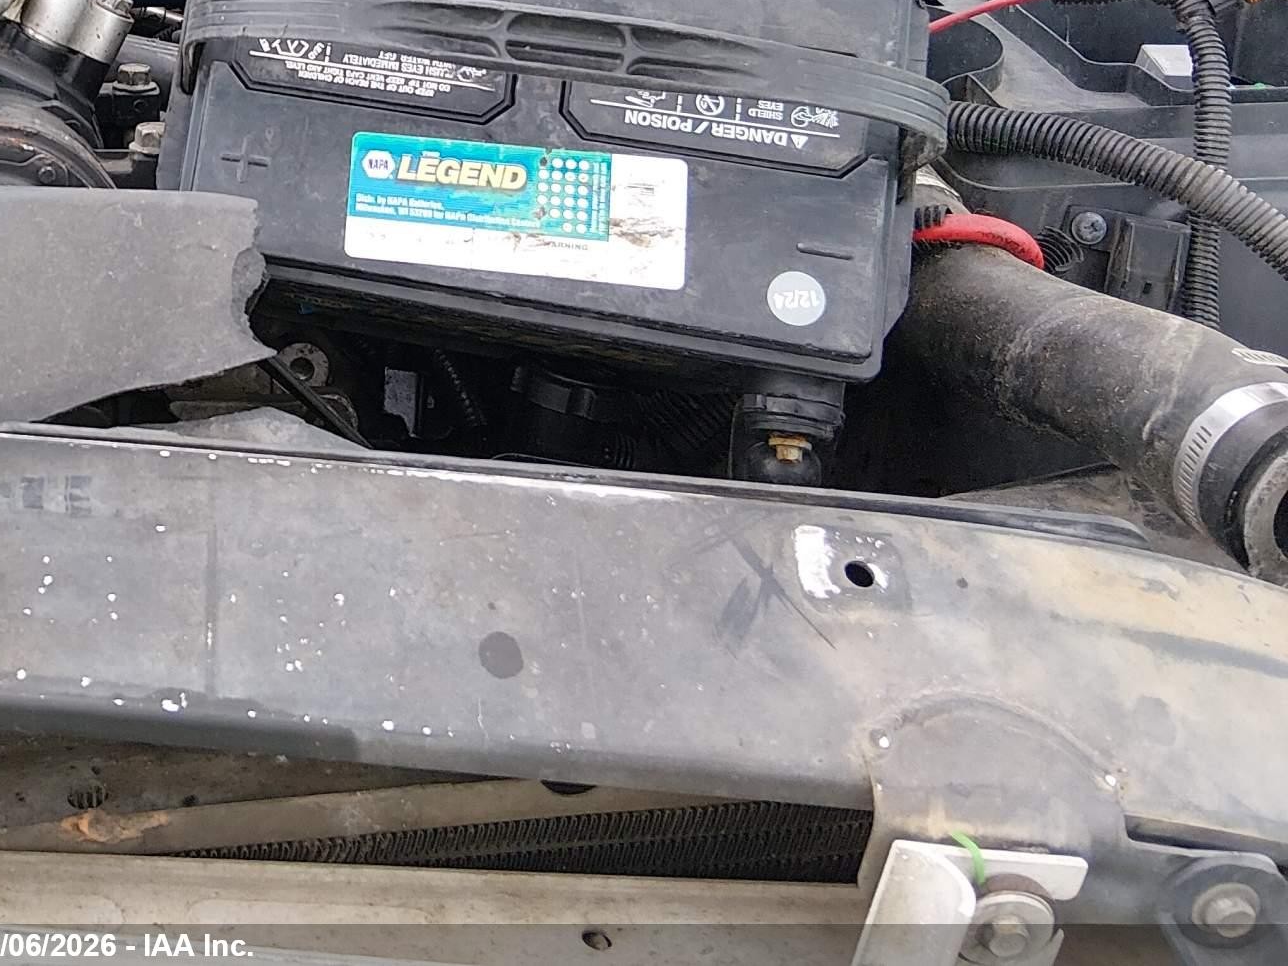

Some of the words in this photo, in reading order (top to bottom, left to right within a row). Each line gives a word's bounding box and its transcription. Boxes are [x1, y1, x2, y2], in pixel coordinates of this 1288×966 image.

[342, 53, 400, 71] IMMEDIATELY
[400, 62, 424, 75] EYES
[333, 76, 344, 84] OF
[345, 77, 369, 88] REACH
[370, 80, 385, 90] THE
[386, 83, 397, 92] OF
[397, 85, 414, 94] OUT
[757, 100, 784, 112] EYES
[748, 107, 783, 121] SHIELD
[624, 109, 693, 134] POISON
[712, 122, 788, 146] DANGER
[367, 158, 390, 171] NAPA
[396, 154, 528, 190] LEGEND
[772, 289, 820, 310] 12/24
